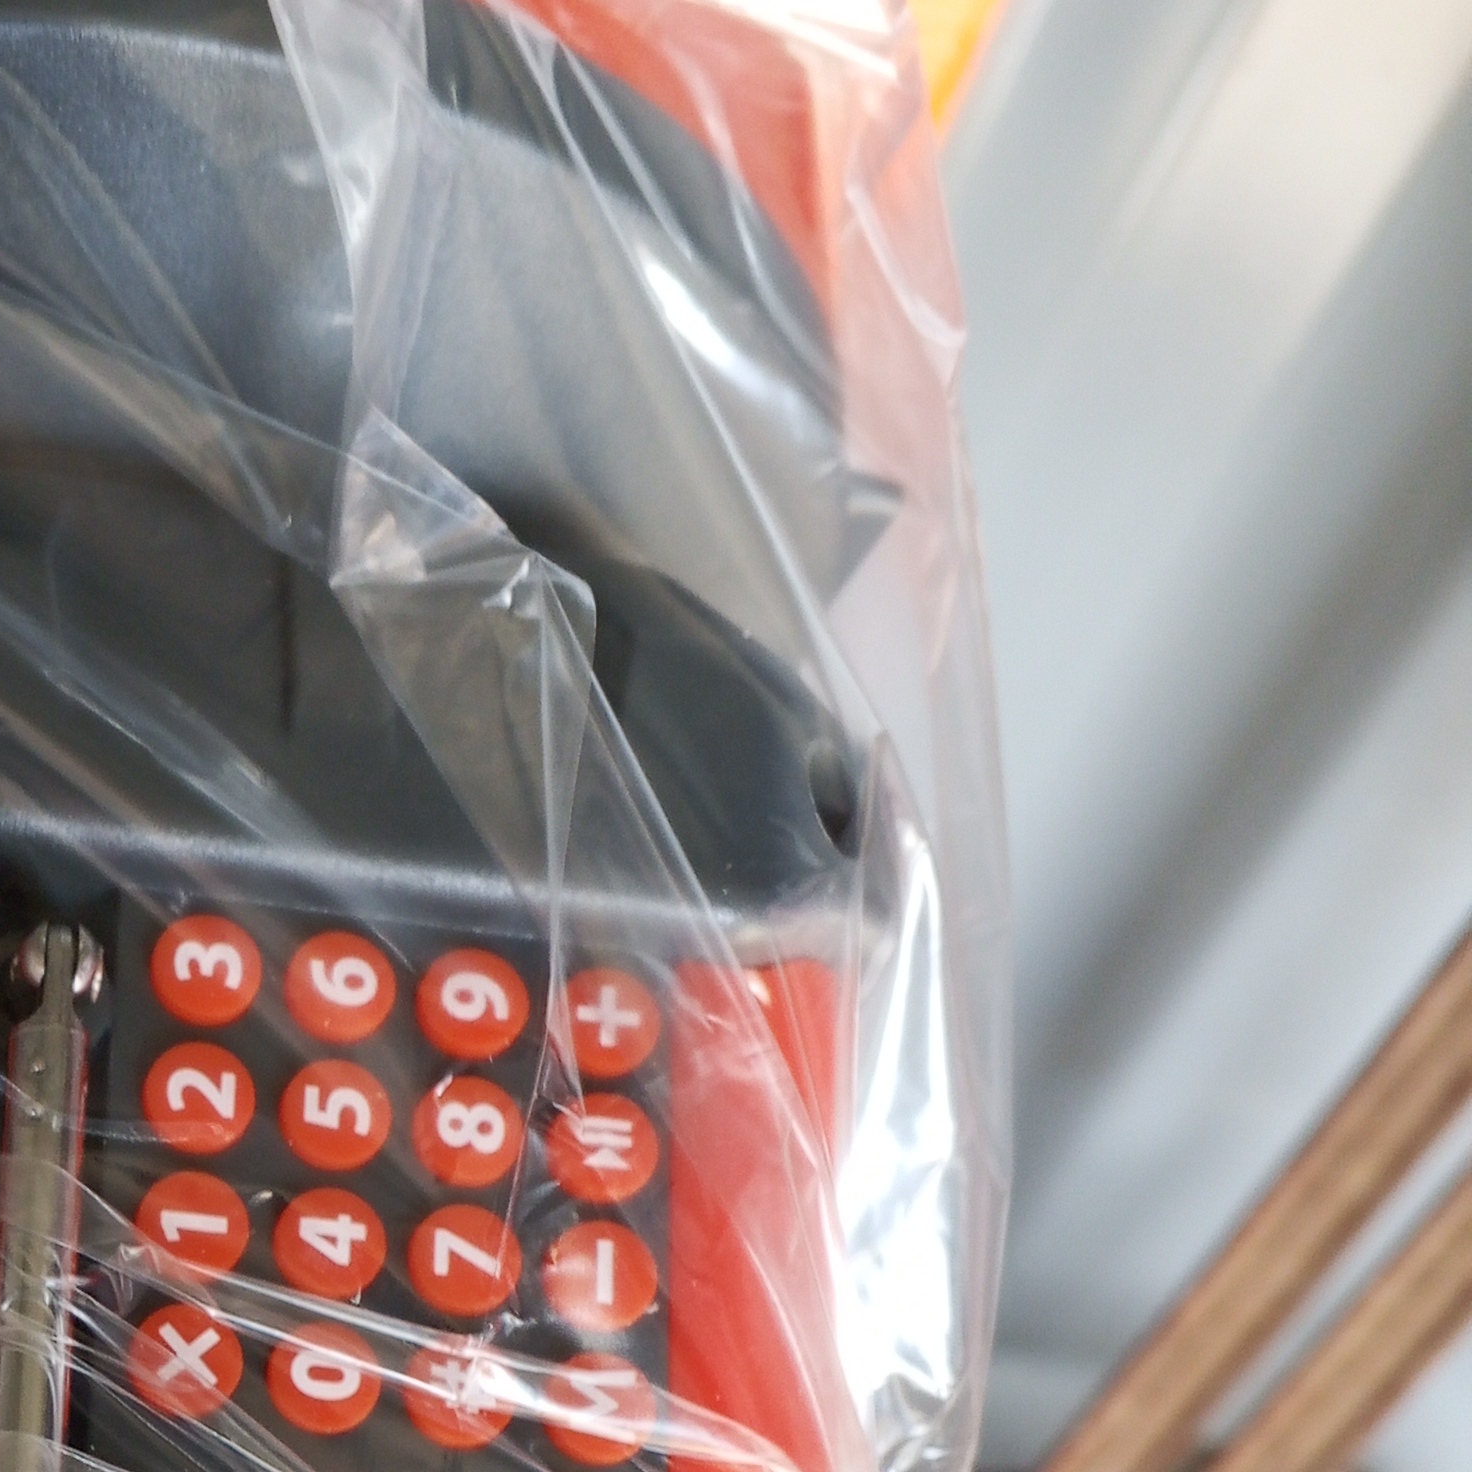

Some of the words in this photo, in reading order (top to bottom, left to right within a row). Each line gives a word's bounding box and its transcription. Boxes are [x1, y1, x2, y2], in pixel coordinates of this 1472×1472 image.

[174, 939, 244, 990] 3
[310, 955, 379, 1008] 6
[440, 971, 511, 1022] 9
[167, 1071, 237, 1119] 2
[303, 1084, 372, 1136] 5
[437, 1101, 507, 1154] 8
[160, 1209, 228, 1241] 1
[299, 1213, 367, 1267] 4
[433, 1227, 501, 1278] 7
